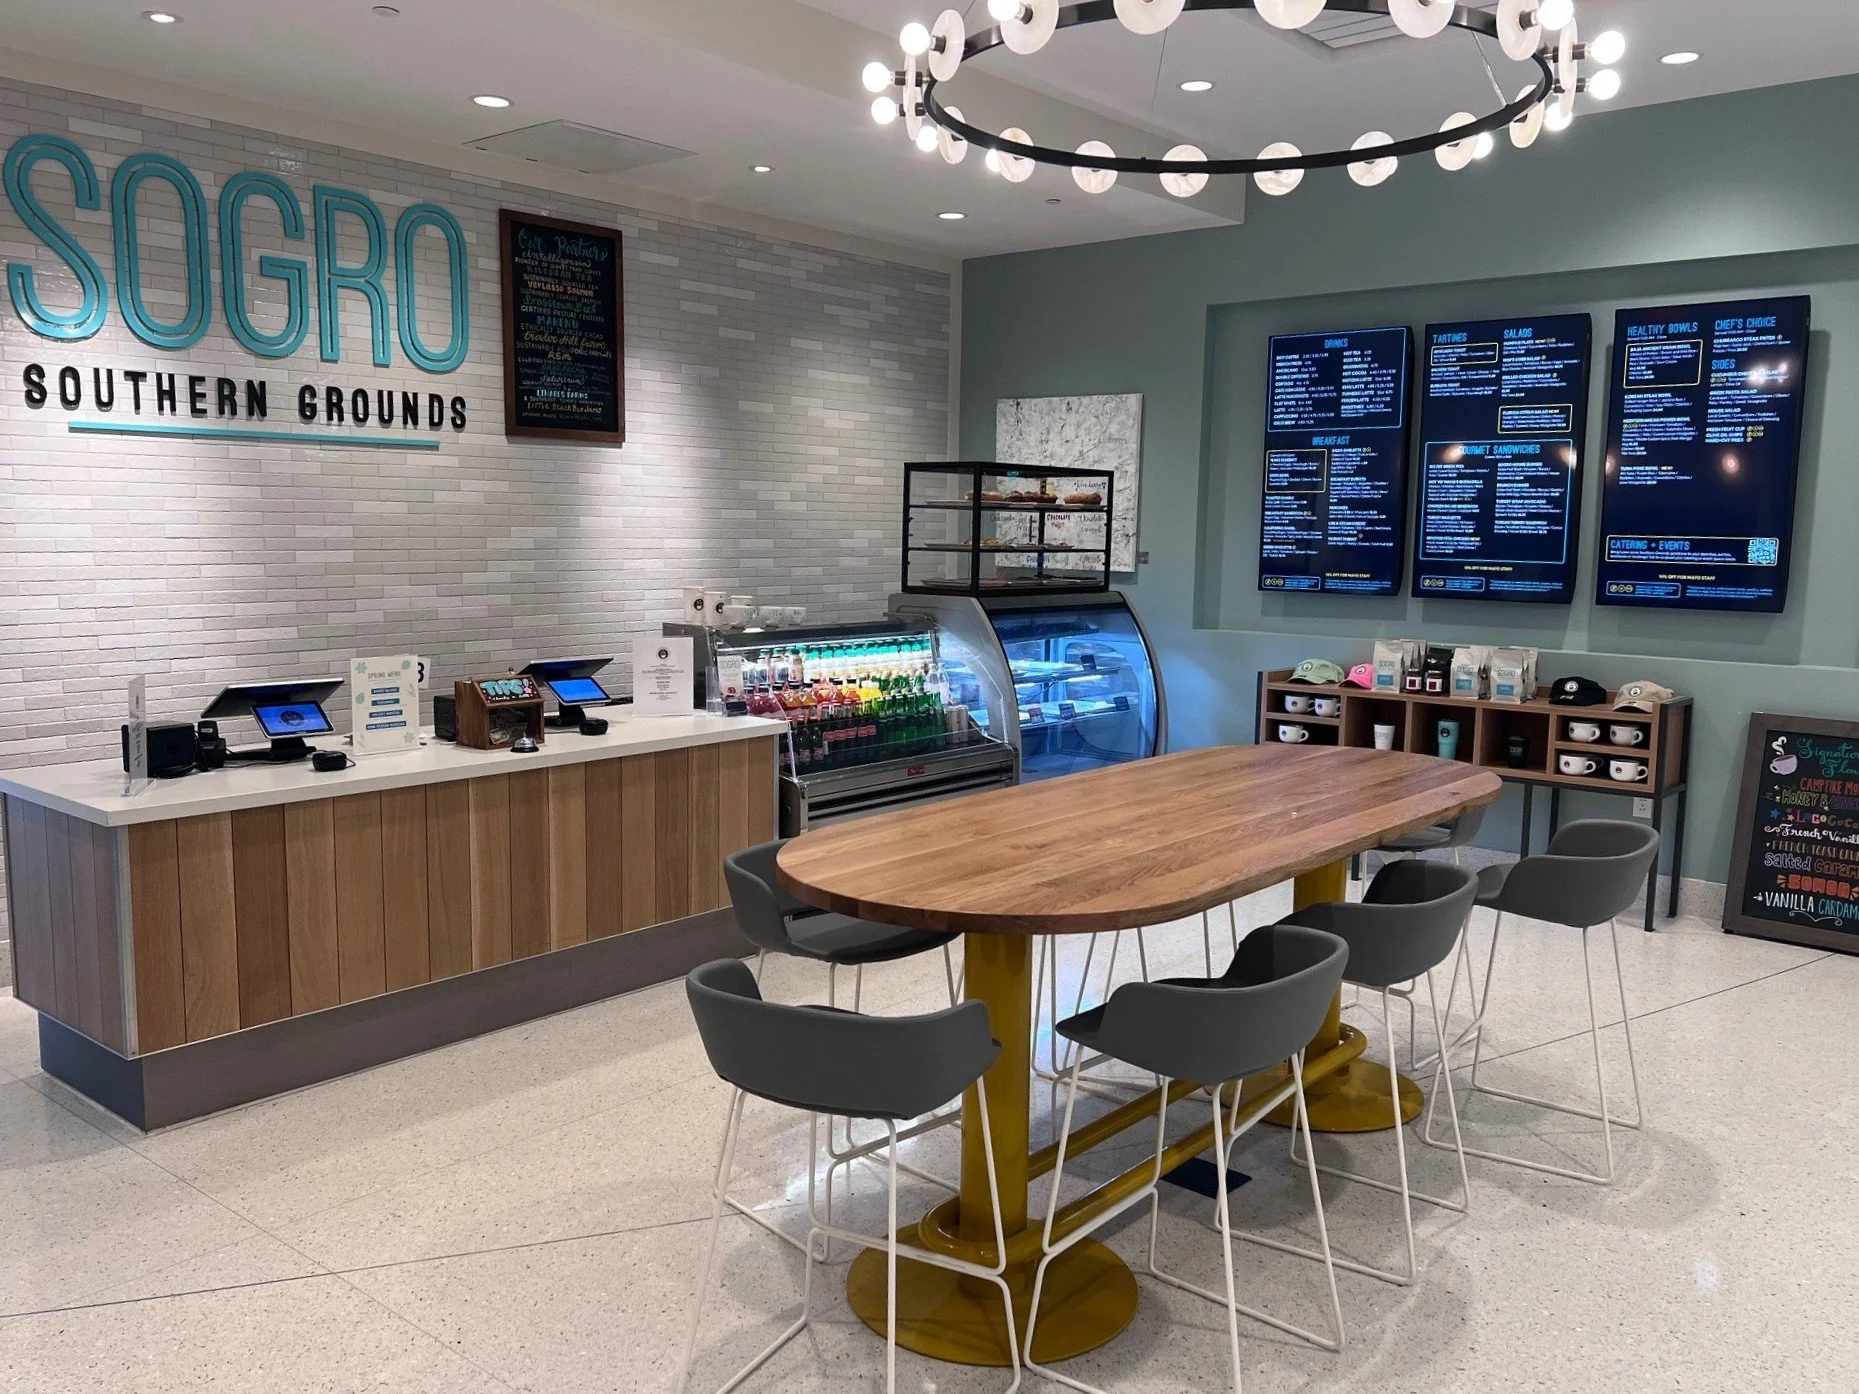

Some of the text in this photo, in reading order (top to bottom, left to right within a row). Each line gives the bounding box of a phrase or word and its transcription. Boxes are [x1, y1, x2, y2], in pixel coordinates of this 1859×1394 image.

[4, 134, 468, 374] SOGRO
[1627, 321, 1699, 337] HEALTHY BOWLS
[1715, 316, 1776, 330] CHEF'S CHOICE
[1324, 338, 1349, 349] DRINKS
[1433, 328, 1533, 344] TARTINES SALADS
[1711, 359, 1736, 370] SIDES
[23, 363, 467, 432] SOUTHERN GROUNDS
[1312, 436, 1350, 446] BREAKFAST
[1459, 444, 1541, 456] GOURMET SANDWICHES
[1609, 540, 1648, 549] CATERING
[1659, 540, 1690, 551] EVENTS
[1782, 789, 1820, 807] HONEY
[1779, 823, 1822, 840] French
[1765, 891, 1814, 913] VANILLA
